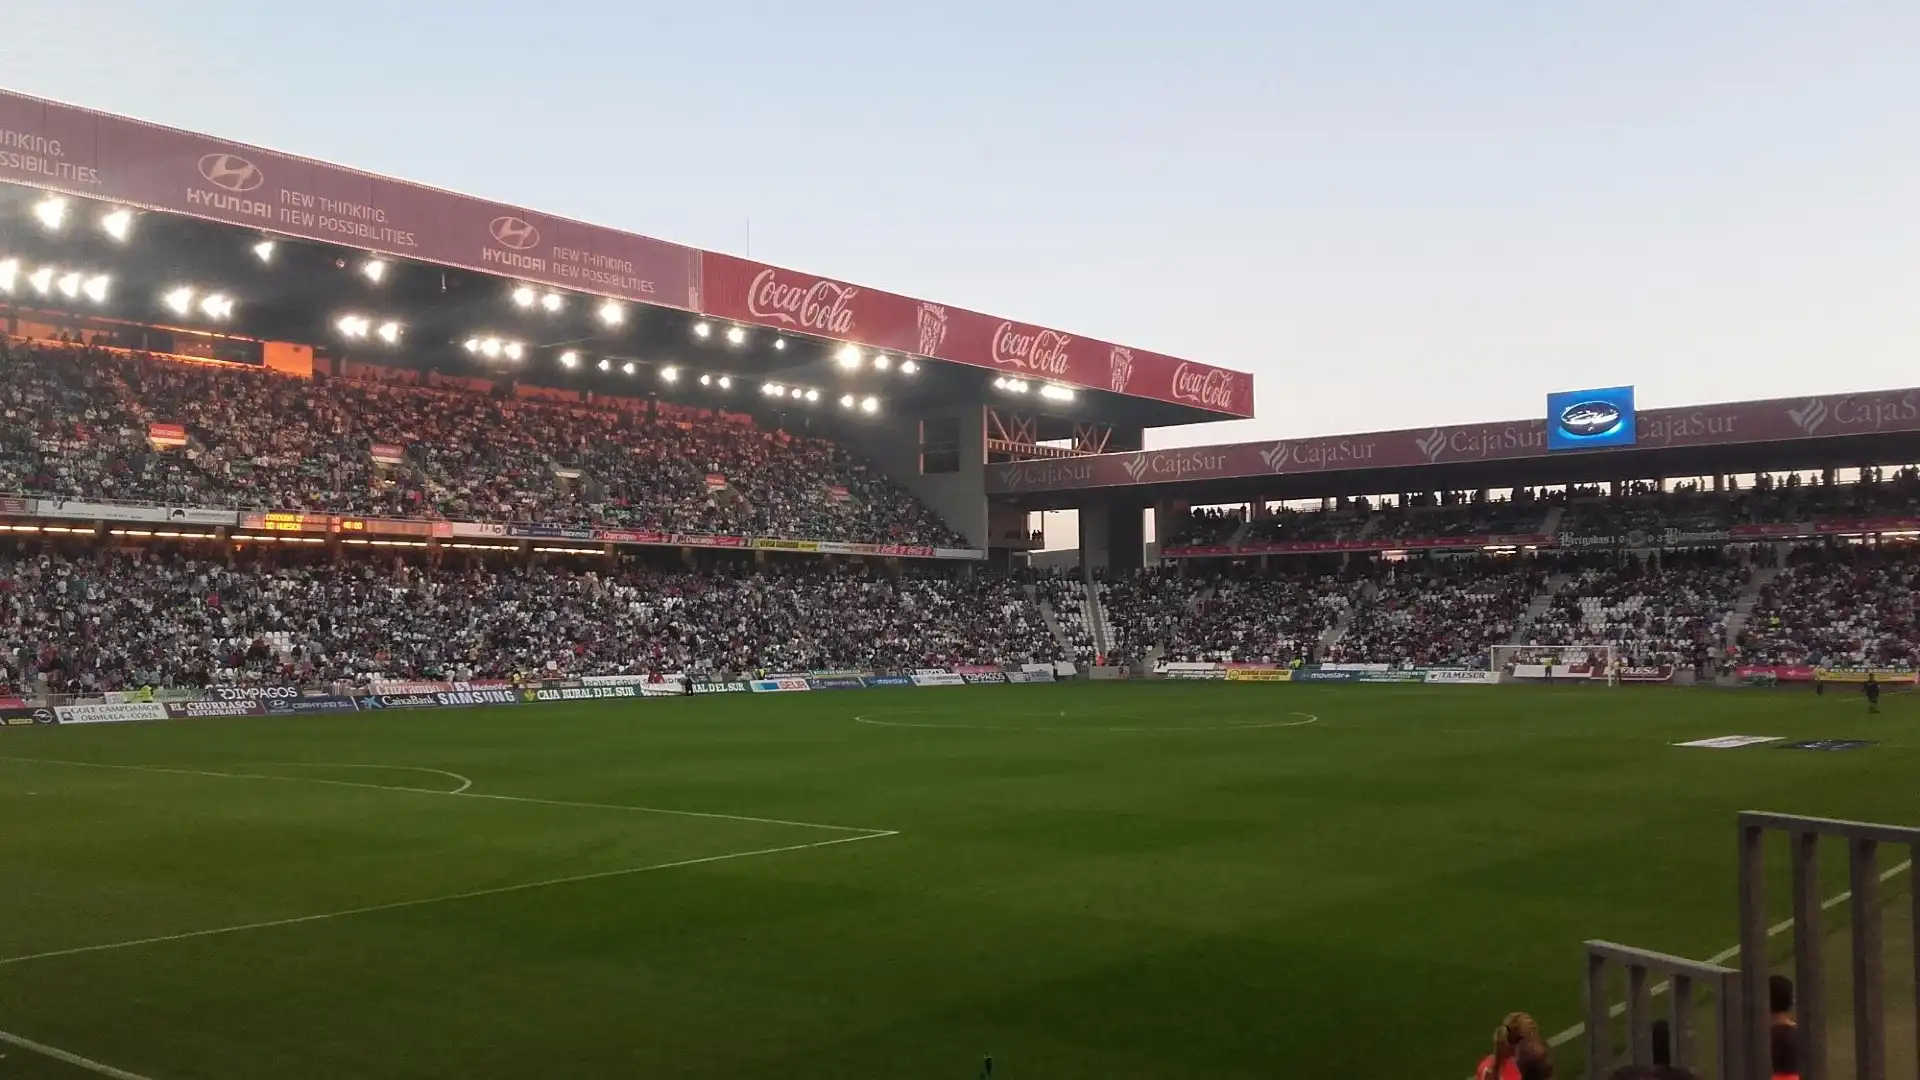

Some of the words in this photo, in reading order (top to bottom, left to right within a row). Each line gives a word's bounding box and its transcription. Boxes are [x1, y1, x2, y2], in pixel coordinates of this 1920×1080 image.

[186, 187, 272, 219] HYUNDAI
[280, 188, 315, 208] NEW
[318, 196, 388, 224] THINKING.
[280, 207, 315, 228] NEW
[318, 217, 419, 248] POSSIBILITIES.
[482, 246, 546, 271] HYUNDAI
[553, 246, 579, 262] NEW
[553, 263, 579, 278] NEW
[1450, 424, 1546, 456] CajaSur
[1152, 450, 1227, 478] CajaSur
[1292, 439, 1377, 470] CajaSur
[1024, 464, 1092, 487] CajaSur
[537, 689, 561, 700] CAJA
[562, 688, 594, 699] RURAL
[594, 687, 615, 698] DEL
[616, 686, 636, 696] SUR
[727, 682, 746, 692] SUR
[170, 702, 186, 711] EL
[187, 699, 257, 711] CHURRASCO
[382, 694, 436, 707] CaixaBank
[438, 690, 516, 705] SAMSUNG
[187, 707, 249, 717] RESTAURANTE
